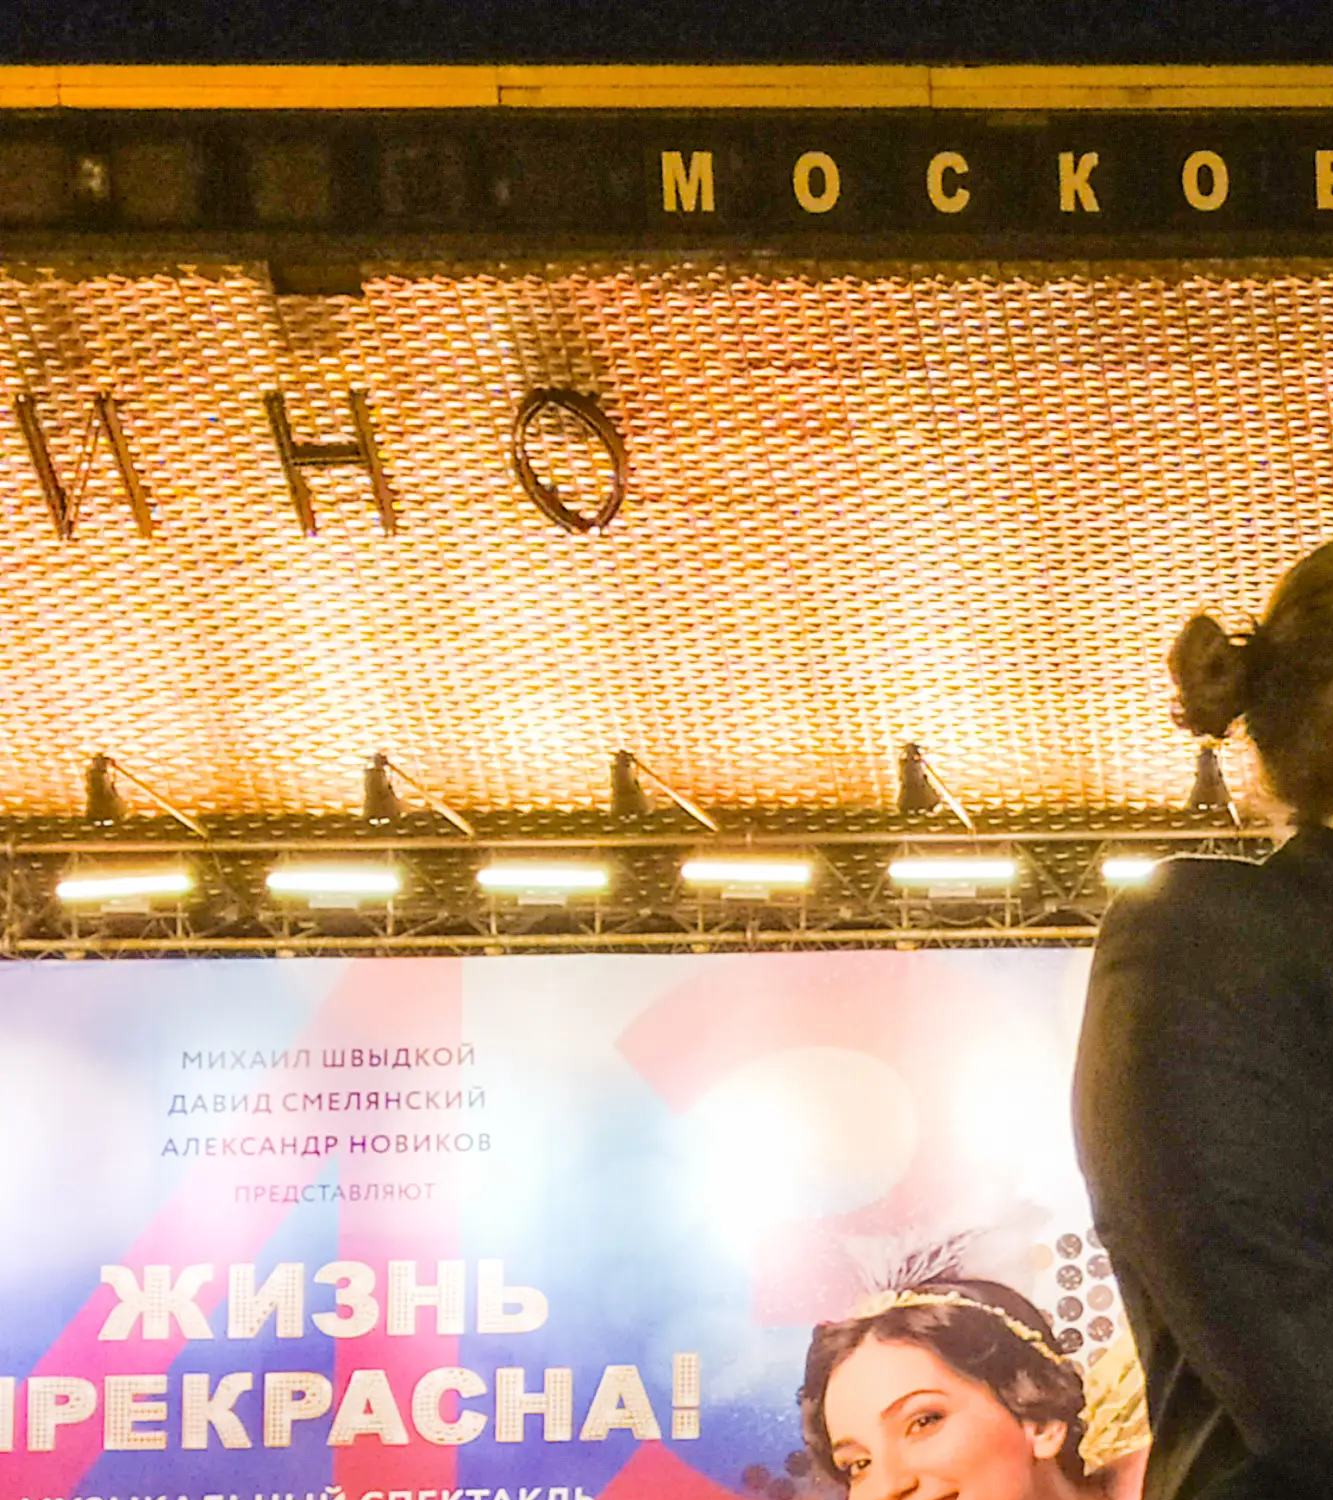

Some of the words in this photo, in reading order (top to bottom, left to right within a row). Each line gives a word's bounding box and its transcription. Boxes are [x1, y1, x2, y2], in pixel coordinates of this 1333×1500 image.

[181, 1047, 312, 1072] МИХАИЛ
[321, 1042, 477, 1069] ШВЫДКОЙ
[167, 1091, 273, 1117] ДАВИД
[281, 1085, 487, 1114] СМЕЛЯНСКИЙ
[160, 1134, 340, 1160] АЛЕКСАНДР
[348, 1131, 492, 1156] НОВИКОВ
[232, 1181, 438, 1206] ПРЕДСТАВЛЯЮТ
[98, 1258, 550, 1343] ЖИЗНЬ
[0, 1350, 703, 1453] РЕКРАСНА!
